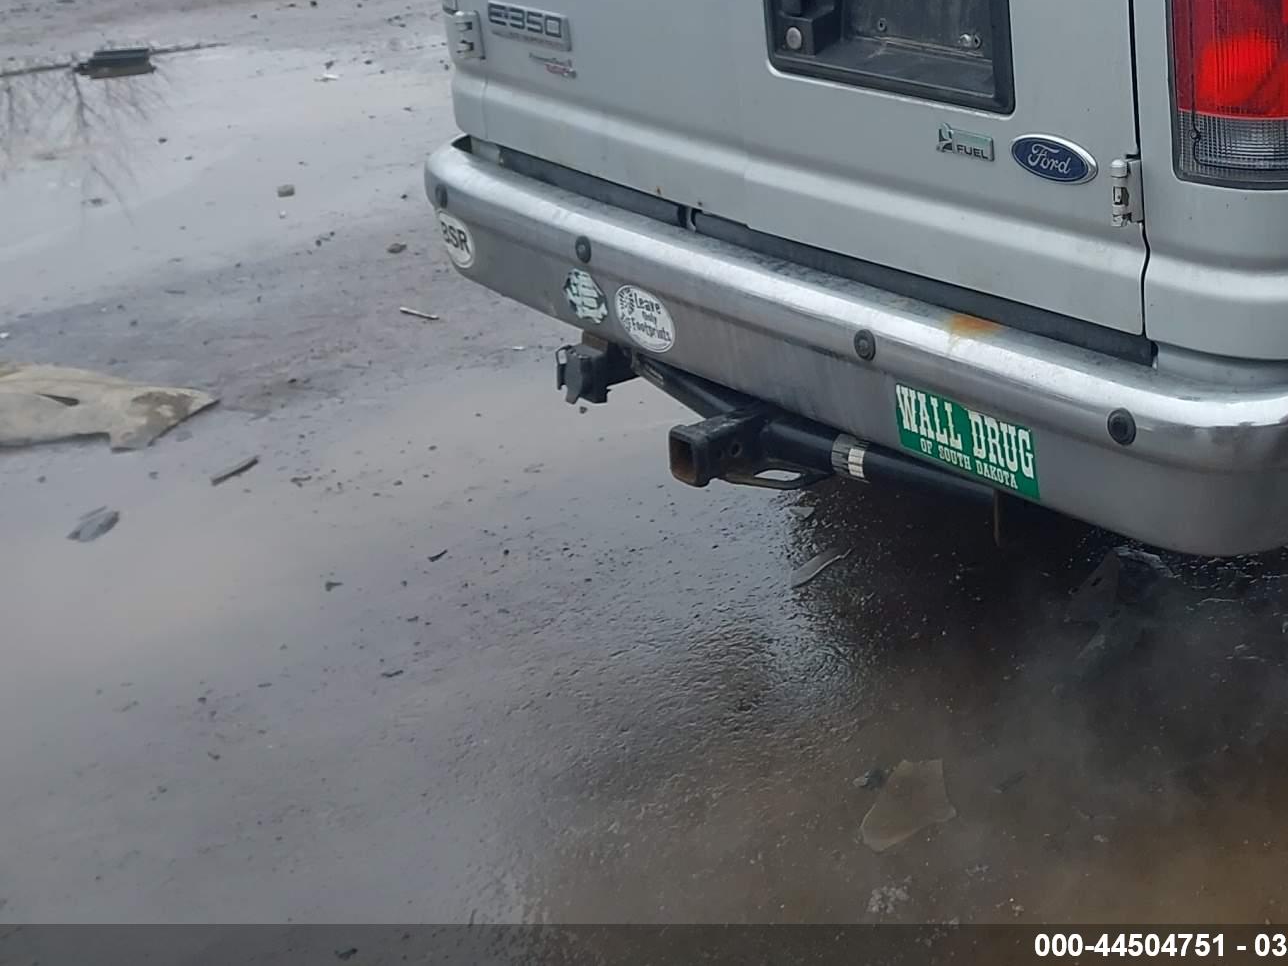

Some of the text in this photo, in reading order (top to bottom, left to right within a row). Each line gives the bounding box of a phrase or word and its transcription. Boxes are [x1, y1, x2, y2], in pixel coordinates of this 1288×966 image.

[956, 143, 989, 160] FUEL
[1027, 142, 1072, 175] Ford
[633, 292, 661, 315] Leave
[896, 384, 1035, 479] WALL DRUG
[919, 437, 1019, 490] OF SOUTH DAKOTA
